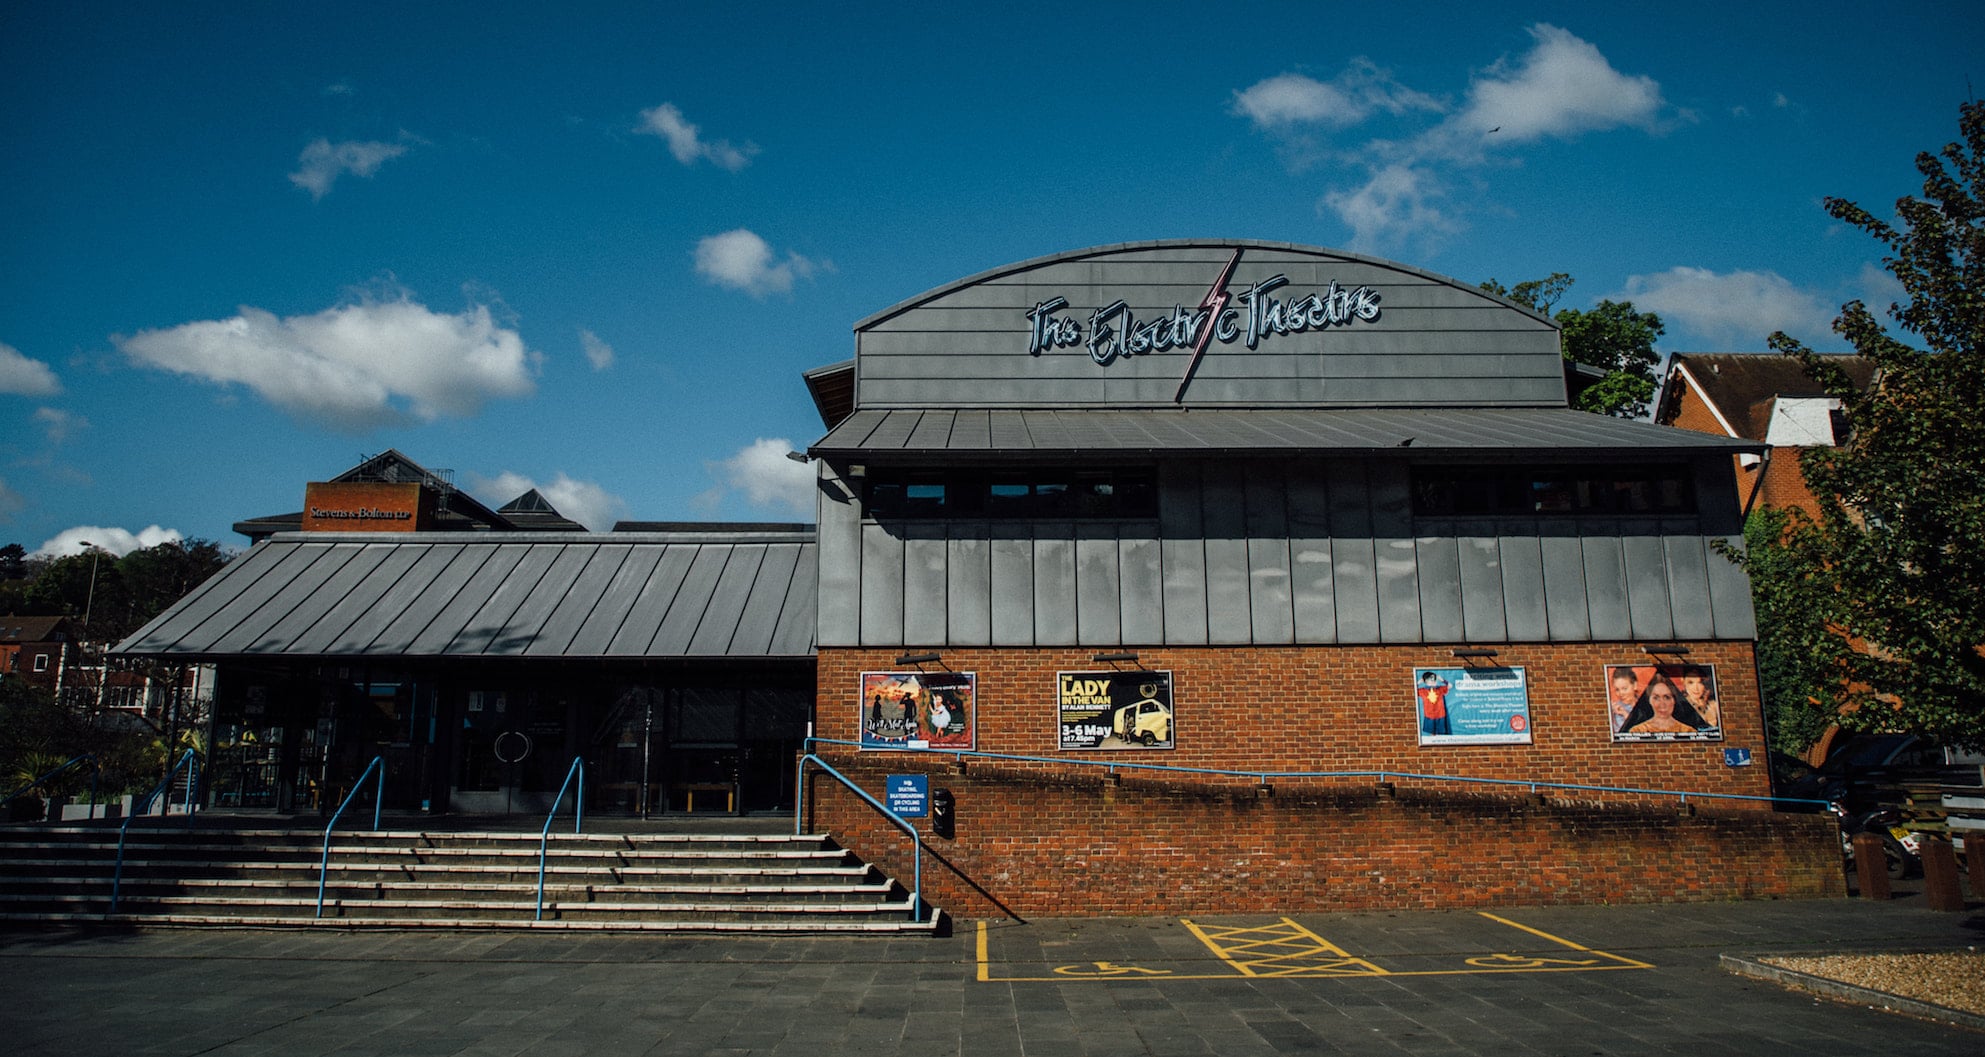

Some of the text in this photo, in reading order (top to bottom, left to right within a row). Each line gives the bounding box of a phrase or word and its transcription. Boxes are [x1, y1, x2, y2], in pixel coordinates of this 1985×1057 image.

[1026, 296, 1082, 356] The
[1238, 274, 1382, 350] Theatre
[311, 506, 347, 518] Stevens
[349, 510, 357, 518] &
[359, 506, 393, 519] Bolton
[1061, 679, 1111, 696] LADY
[1062, 696, 1111, 705] IN THE VAN
[1062, 725, 1112, 739] 3-6 May
